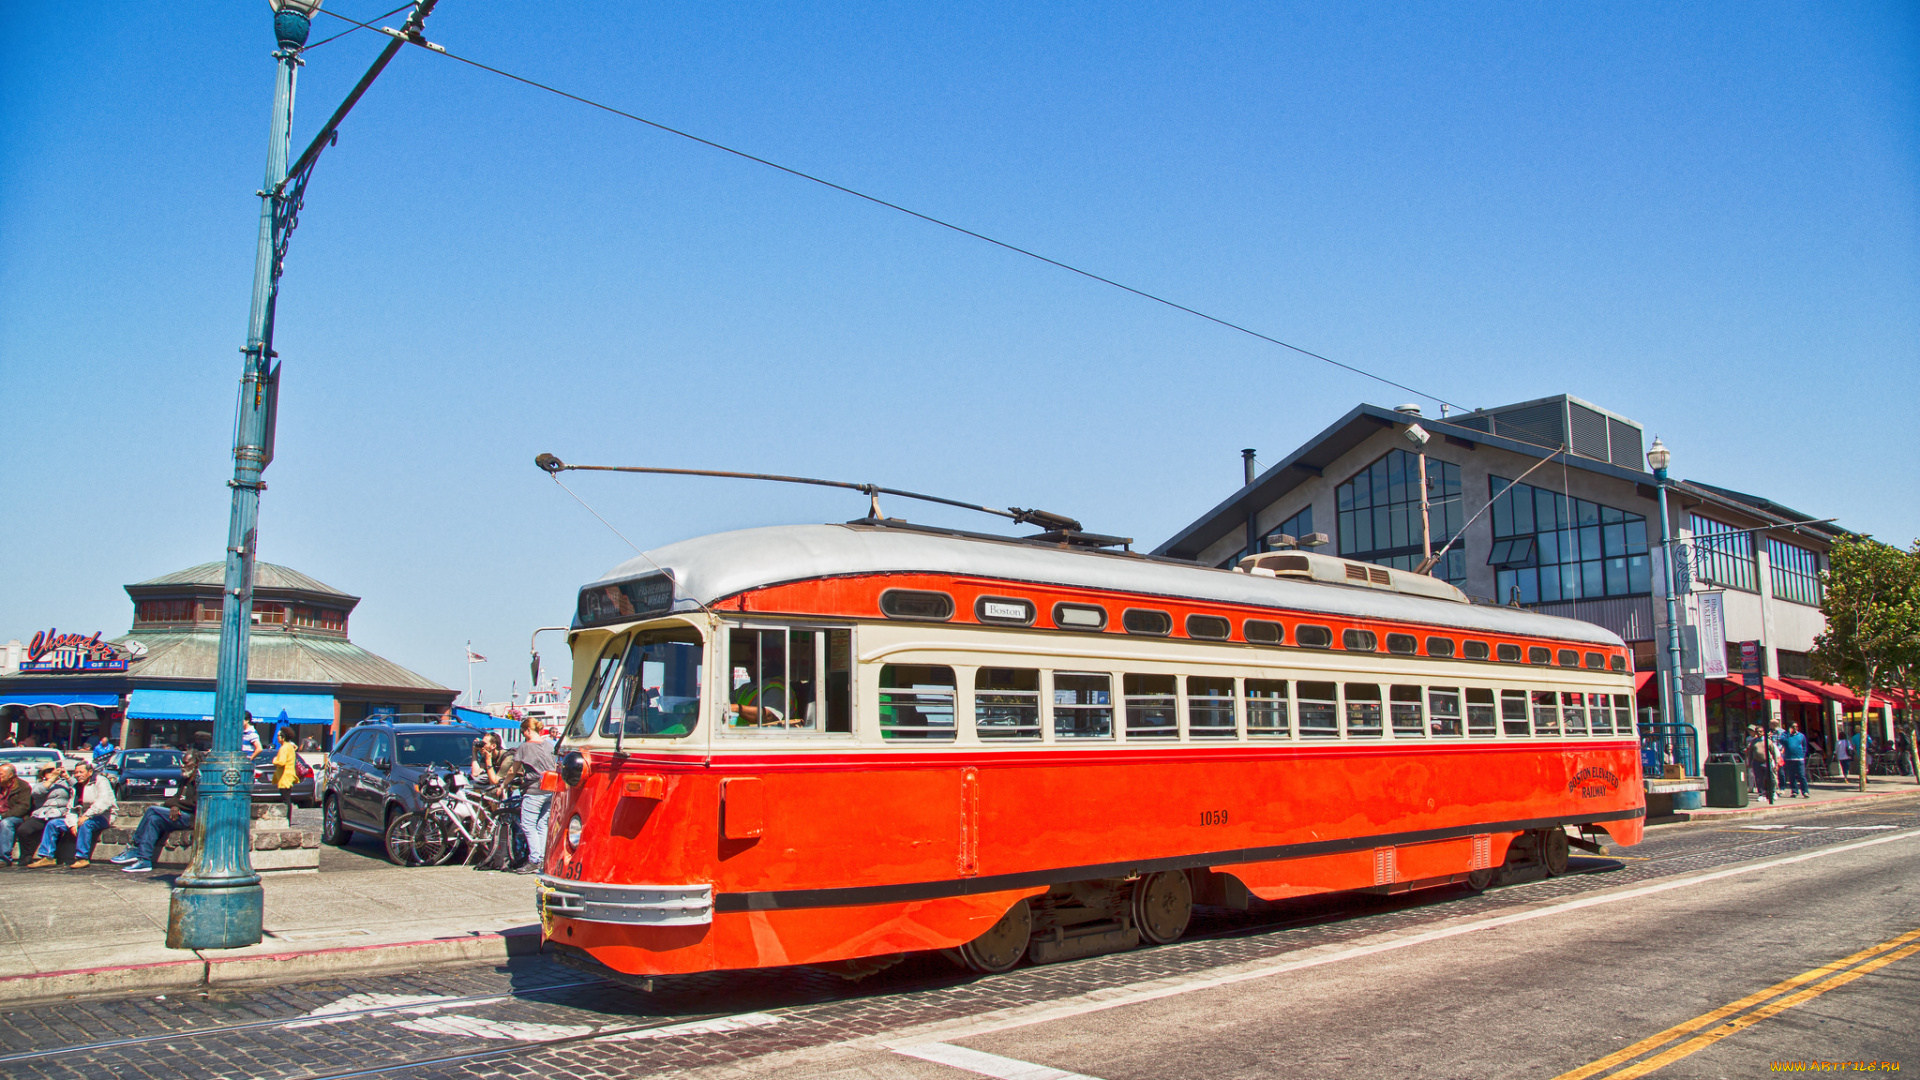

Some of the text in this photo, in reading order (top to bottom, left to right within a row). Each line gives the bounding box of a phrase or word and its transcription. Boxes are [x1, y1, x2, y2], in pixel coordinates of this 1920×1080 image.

[647, 592, 670, 606] WHARF
[990, 604, 1021, 616] Boston
[1711, 598, 1719, 650] DEMONSTRATION
[28, 627, 115, 660] Chowder
[51, 649, 89, 669] HUT
[1568, 766, 1619, 793] BOSTON ELEVATED
[1582, 785, 1607, 799] RAILWAY
[1200, 809, 1228, 826] 1059
